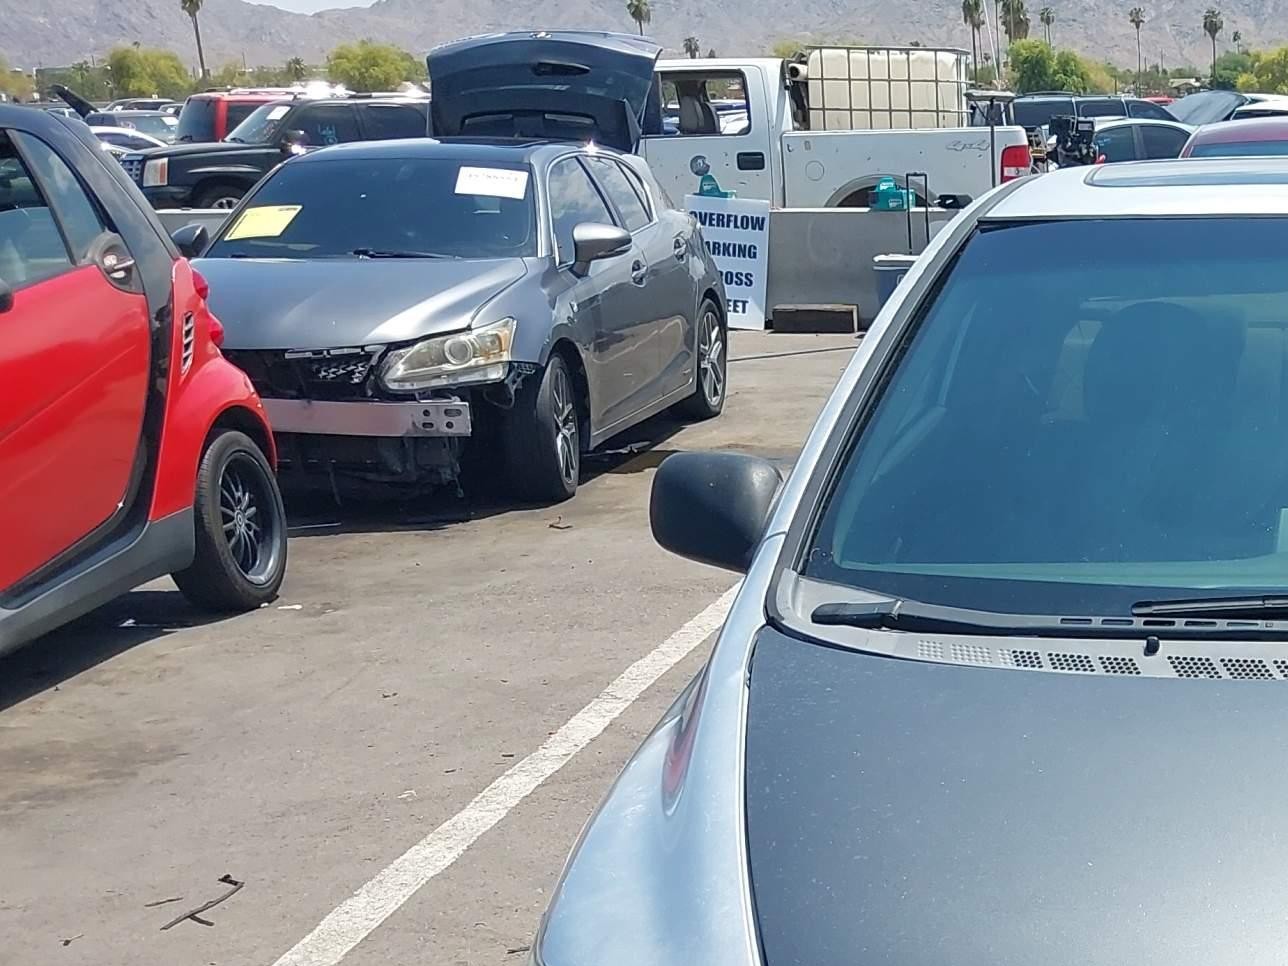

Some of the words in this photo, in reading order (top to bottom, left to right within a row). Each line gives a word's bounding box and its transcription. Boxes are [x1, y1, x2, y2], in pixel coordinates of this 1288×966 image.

[704, 240, 758, 260] ARKING
[718, 269, 754, 288] OSS
[727, 298, 749, 314] EET
